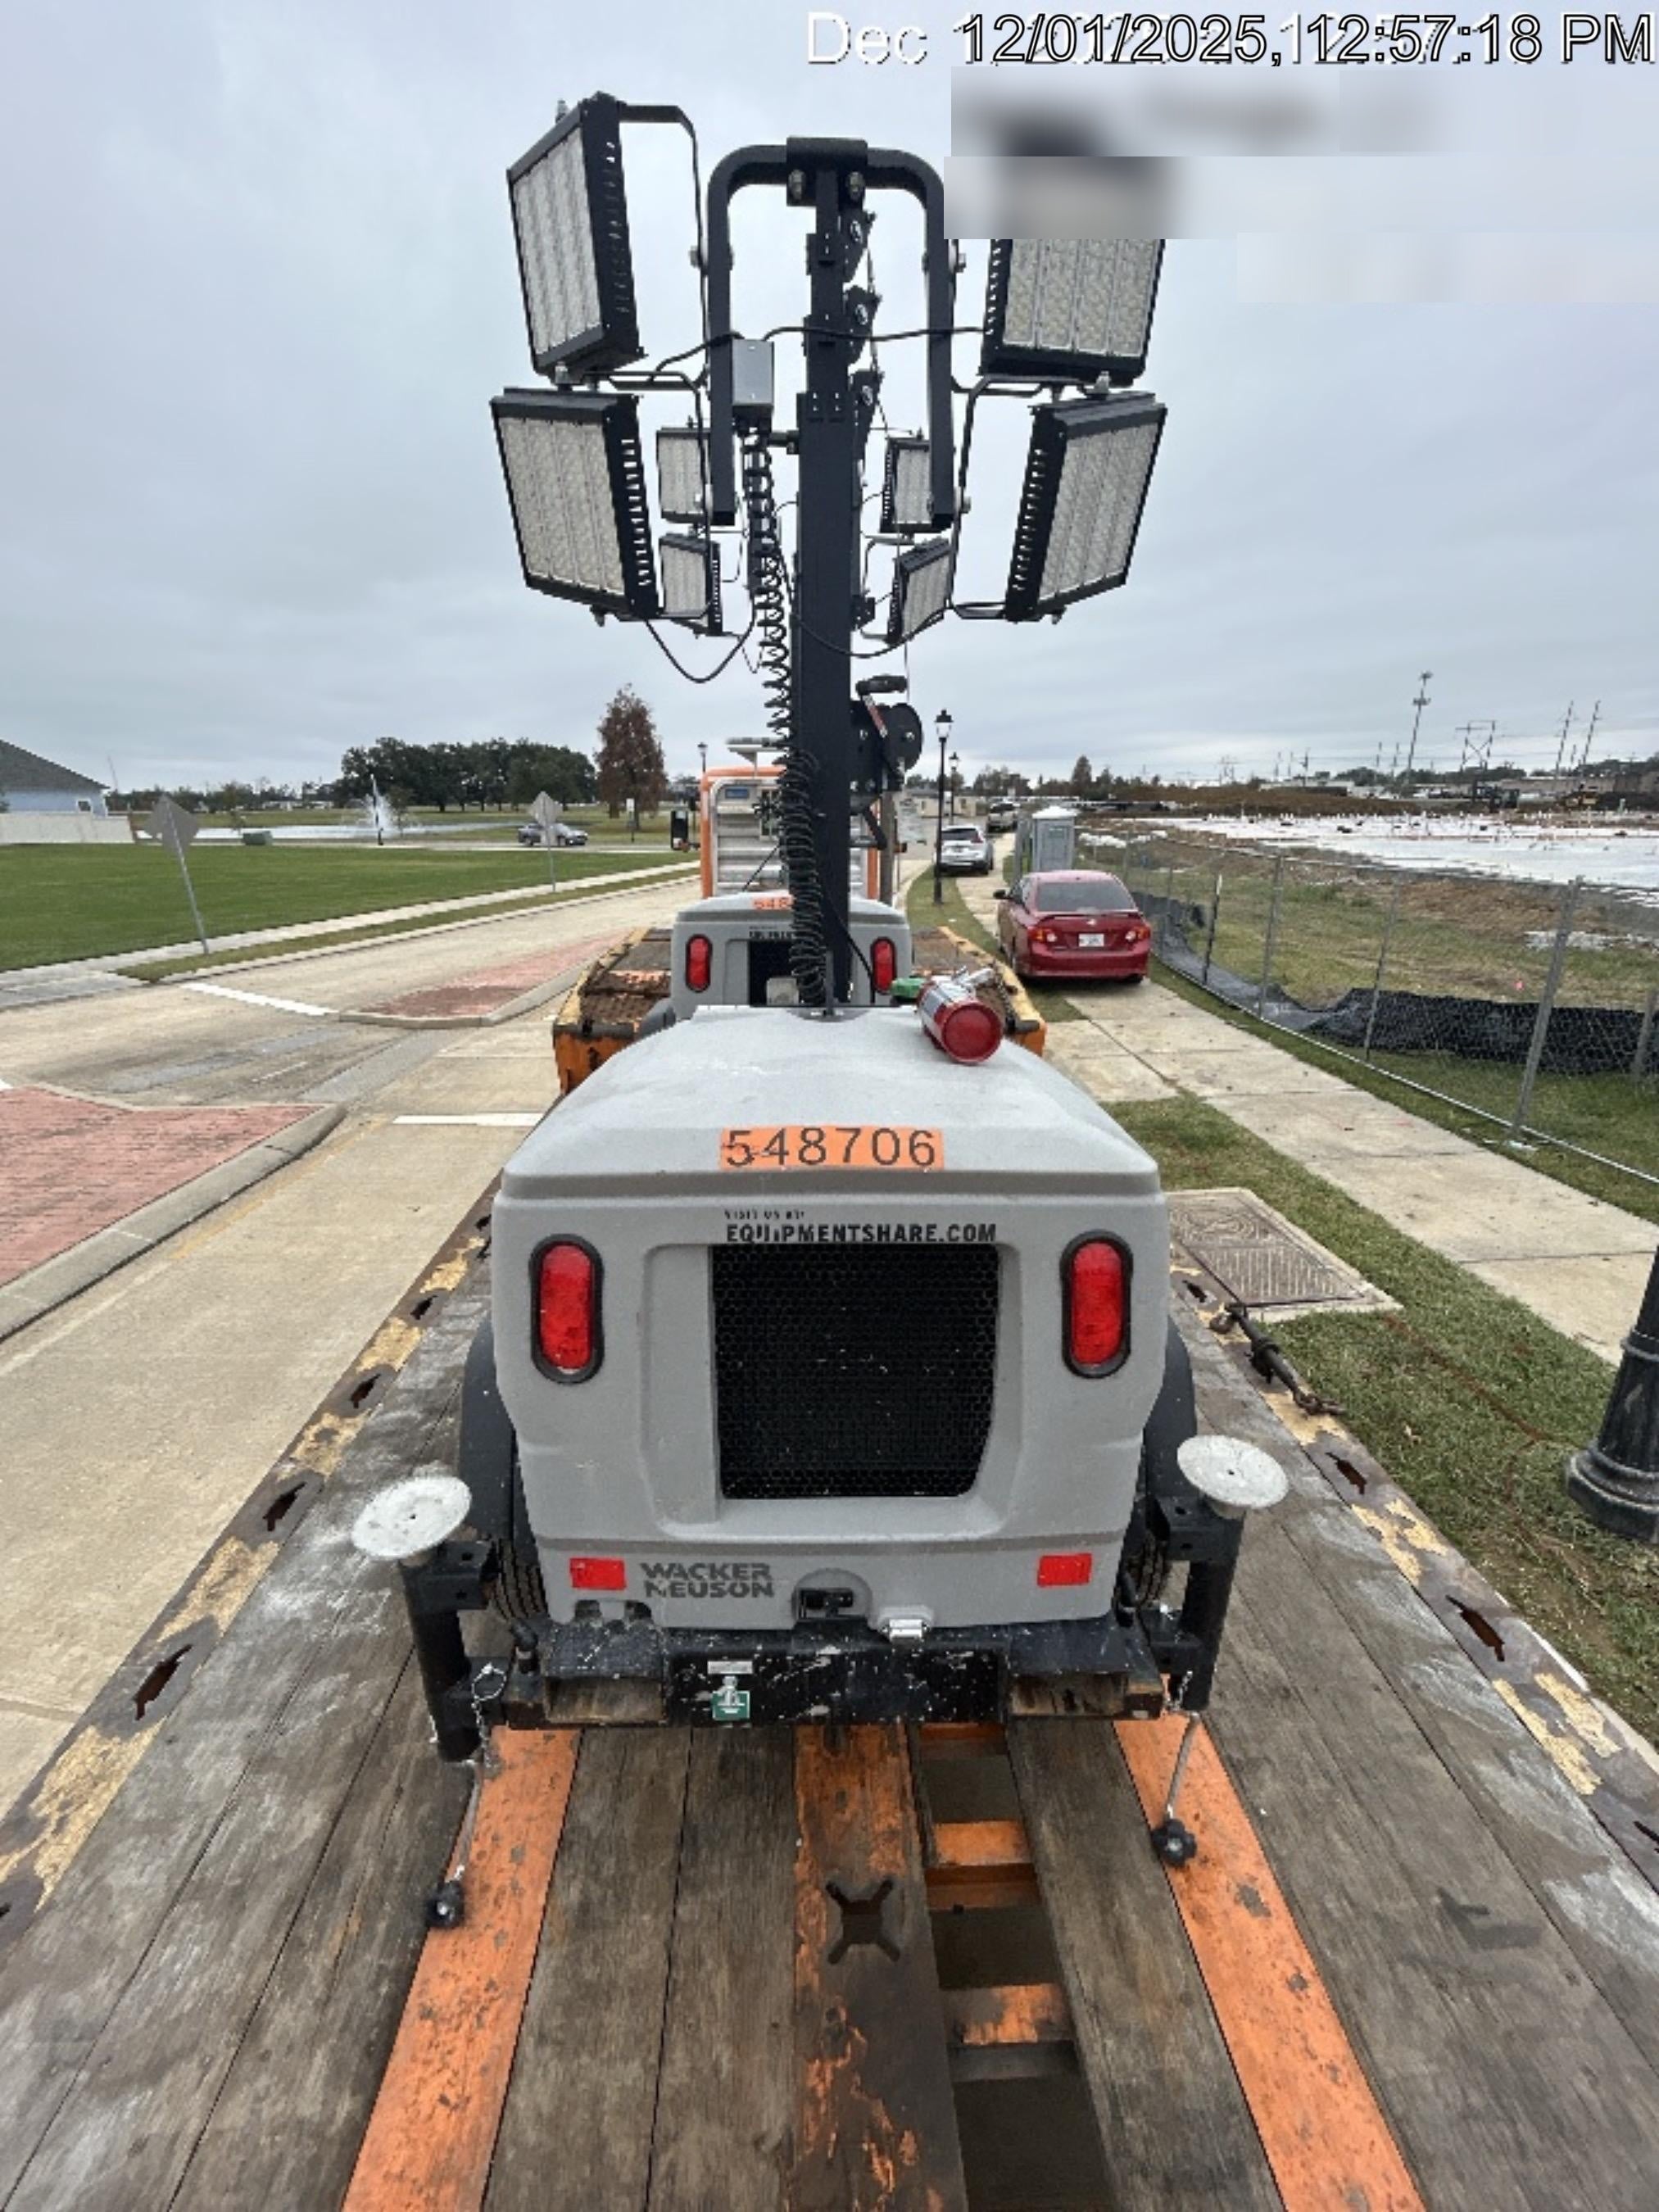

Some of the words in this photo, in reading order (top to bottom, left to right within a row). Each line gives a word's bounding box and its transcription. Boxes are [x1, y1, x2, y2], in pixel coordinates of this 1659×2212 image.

[725, 1127, 936, 1167] 548706
[727, 1223, 997, 1244] EQUIPMENTSHARE.COM
[639, 1562, 773, 1580] WACKER
[643, 1580, 775, 1598] NEUSON
